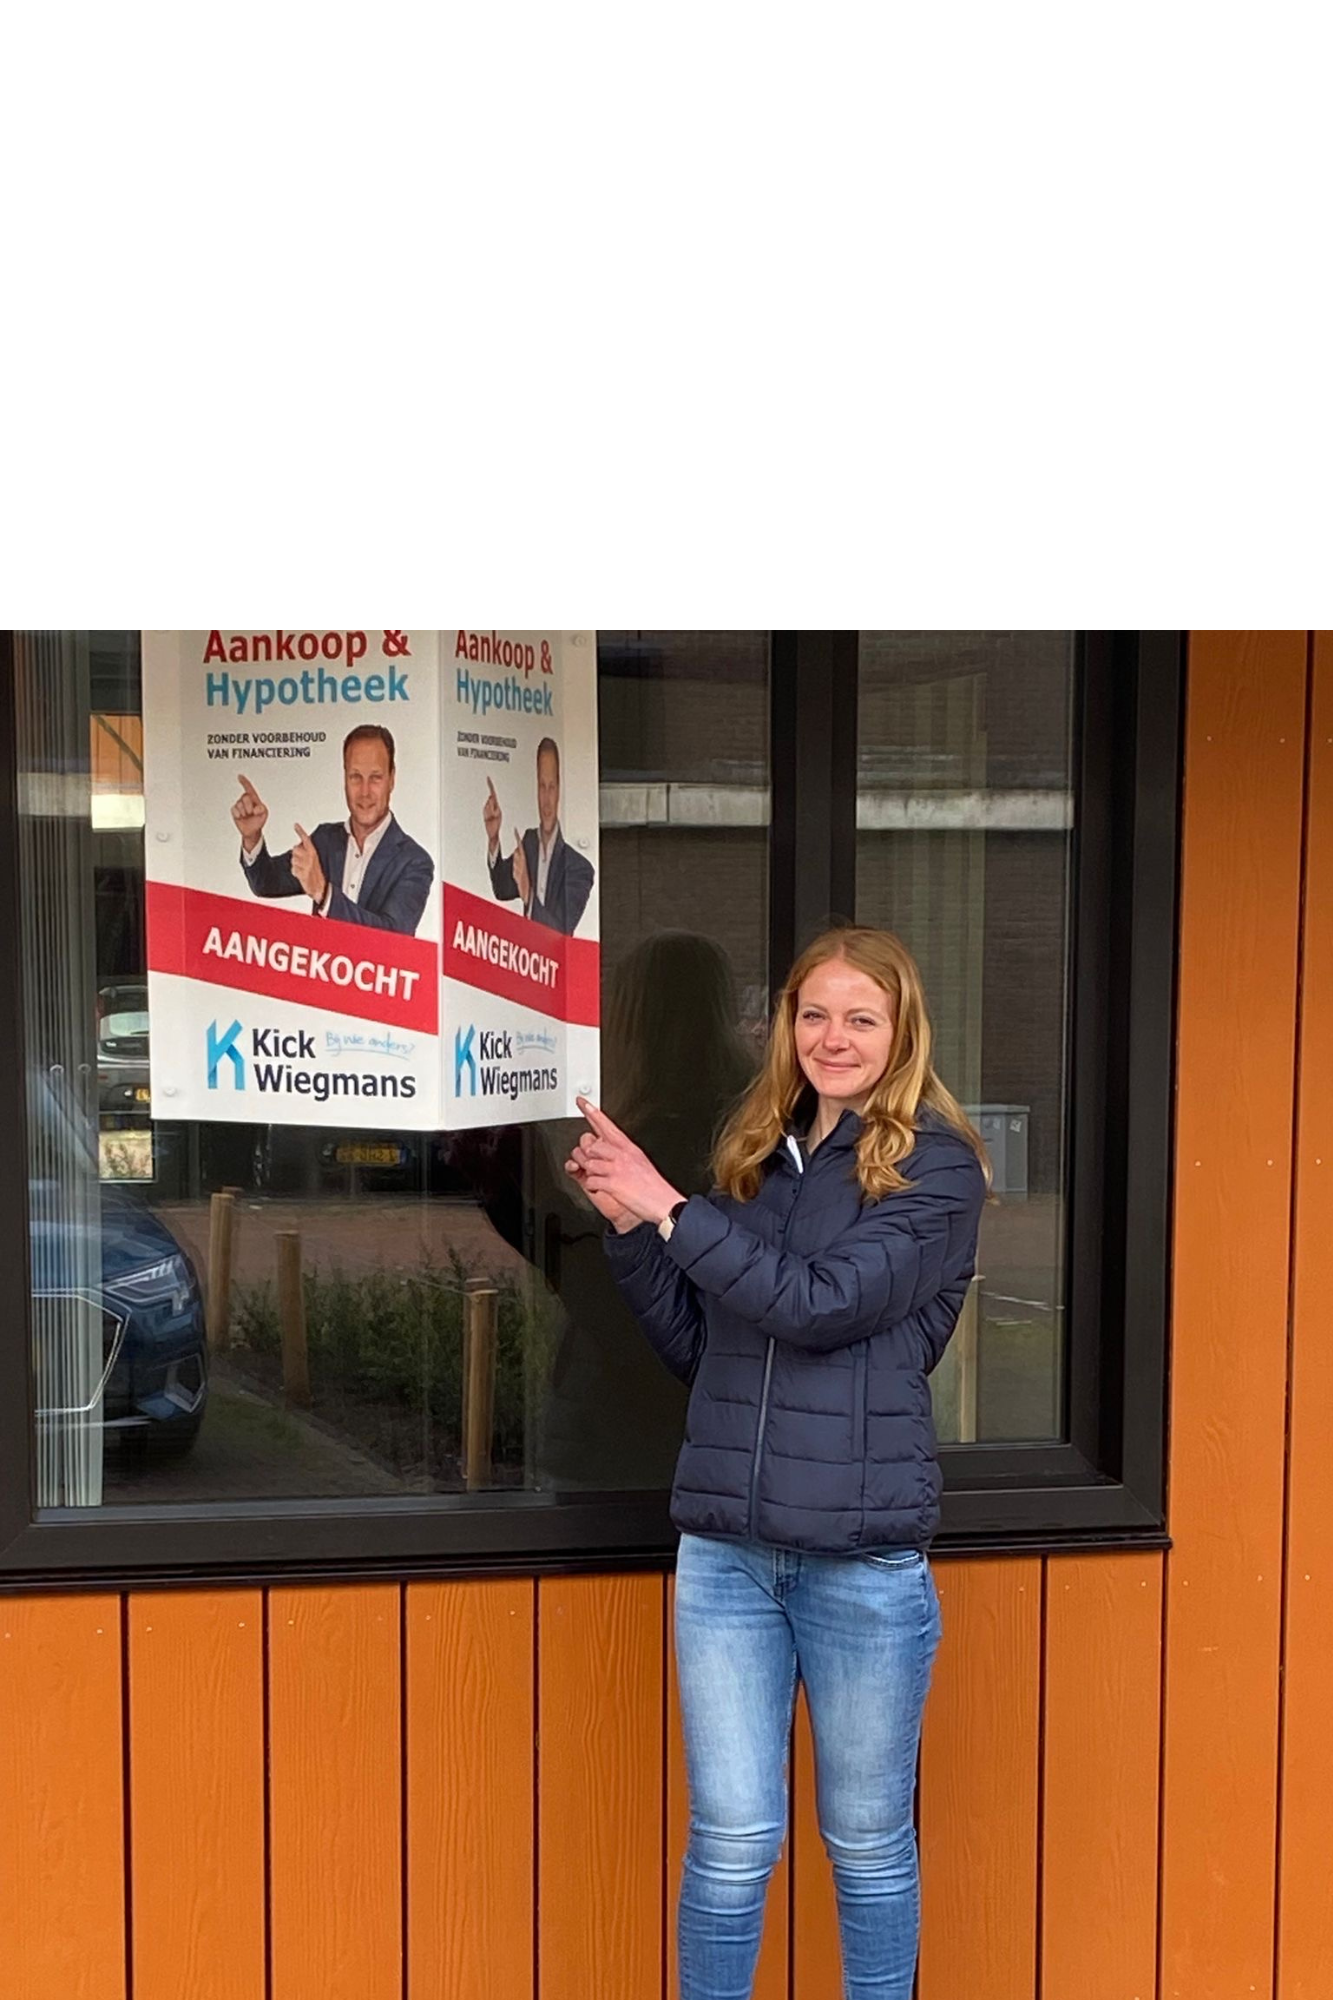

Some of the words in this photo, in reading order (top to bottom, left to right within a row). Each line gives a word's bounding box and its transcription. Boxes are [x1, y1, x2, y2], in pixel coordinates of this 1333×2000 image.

[203, 630, 367, 667] Aankoop
[382, 630, 411, 657] &
[455, 630, 535, 679] Aankoop
[540, 639, 553, 675] &
[206, 665, 410, 714] Hypotheek
[457, 667, 553, 716] Hypotheek
[207, 733, 250, 745] ZONDER
[252, 731, 327, 743] VOORBEHOUD
[207, 748, 229, 759] VAN
[232, 747, 311, 759] FINANCIERING
[202, 926, 420, 1001] AANGEKOCHT
[453, 921, 559, 988] AANGEKOCHT
[252, 1028, 316, 1059] Kick
[479, 1030, 512, 1060] Kick
[253, 1064, 416, 1101] Wiegmans
[480, 1066, 558, 1100] Wiegmans
